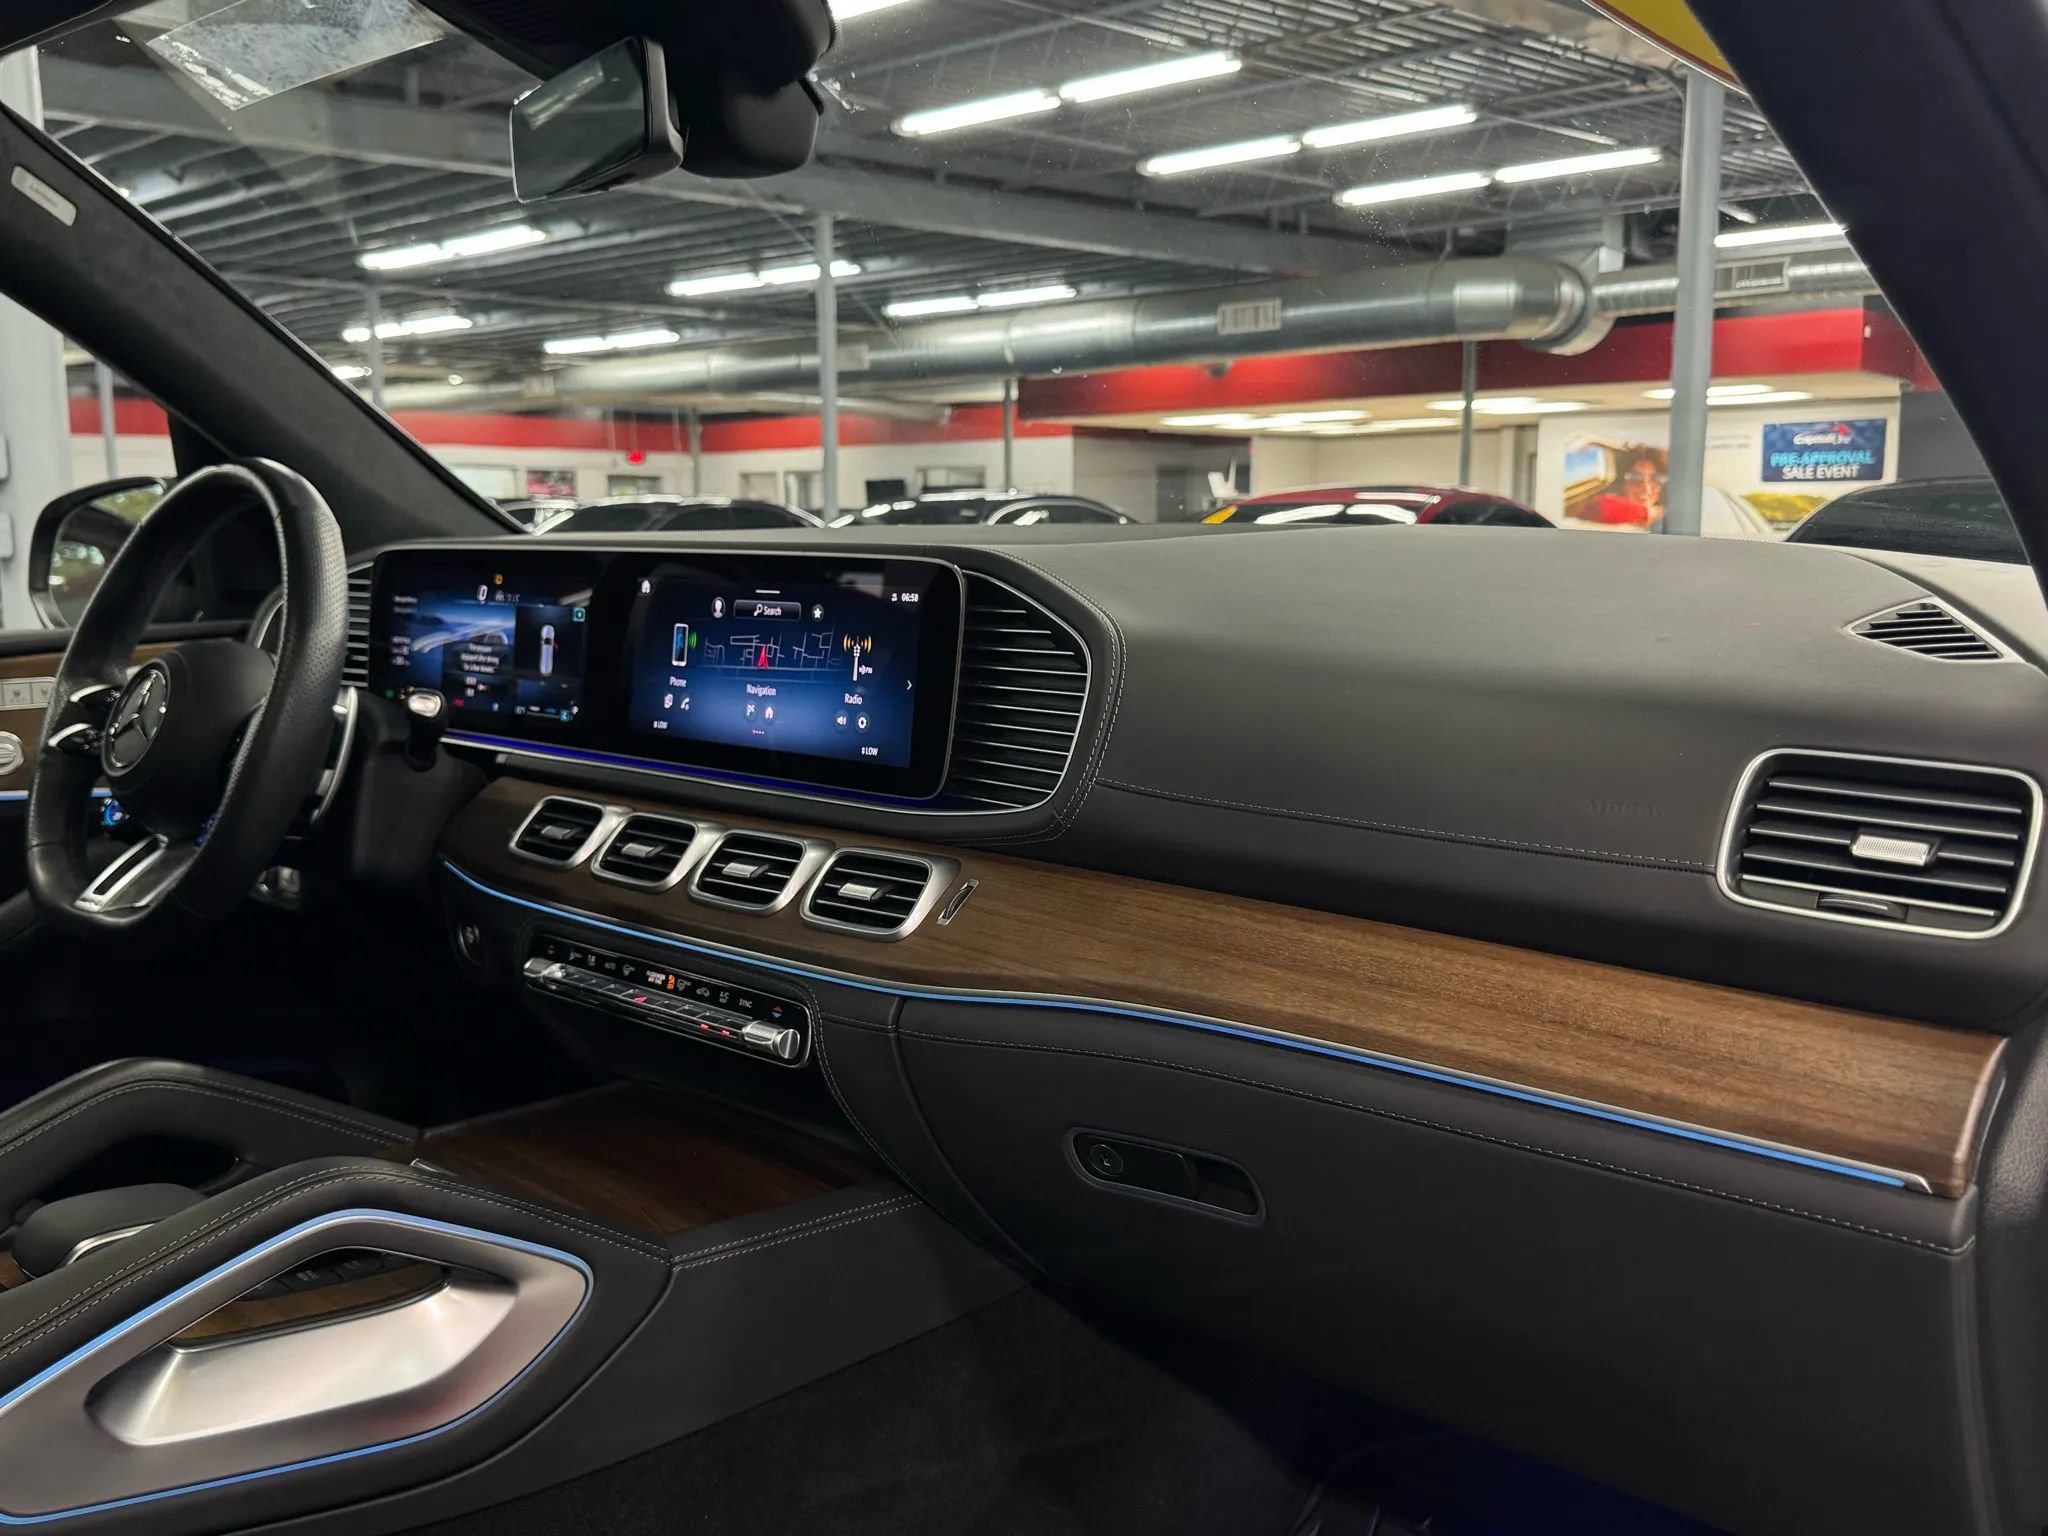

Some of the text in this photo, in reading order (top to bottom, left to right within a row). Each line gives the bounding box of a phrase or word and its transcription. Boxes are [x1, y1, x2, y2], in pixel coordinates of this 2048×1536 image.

[1782, 463, 1860, 479] SALE EVENT
[763, 605, 782, 616] Search
[669, 676, 687, 687] Phone
[746, 683, 777, 697] Navigation
[844, 693, 863, 705] Radio
[865, 746, 879, 756] LOW
